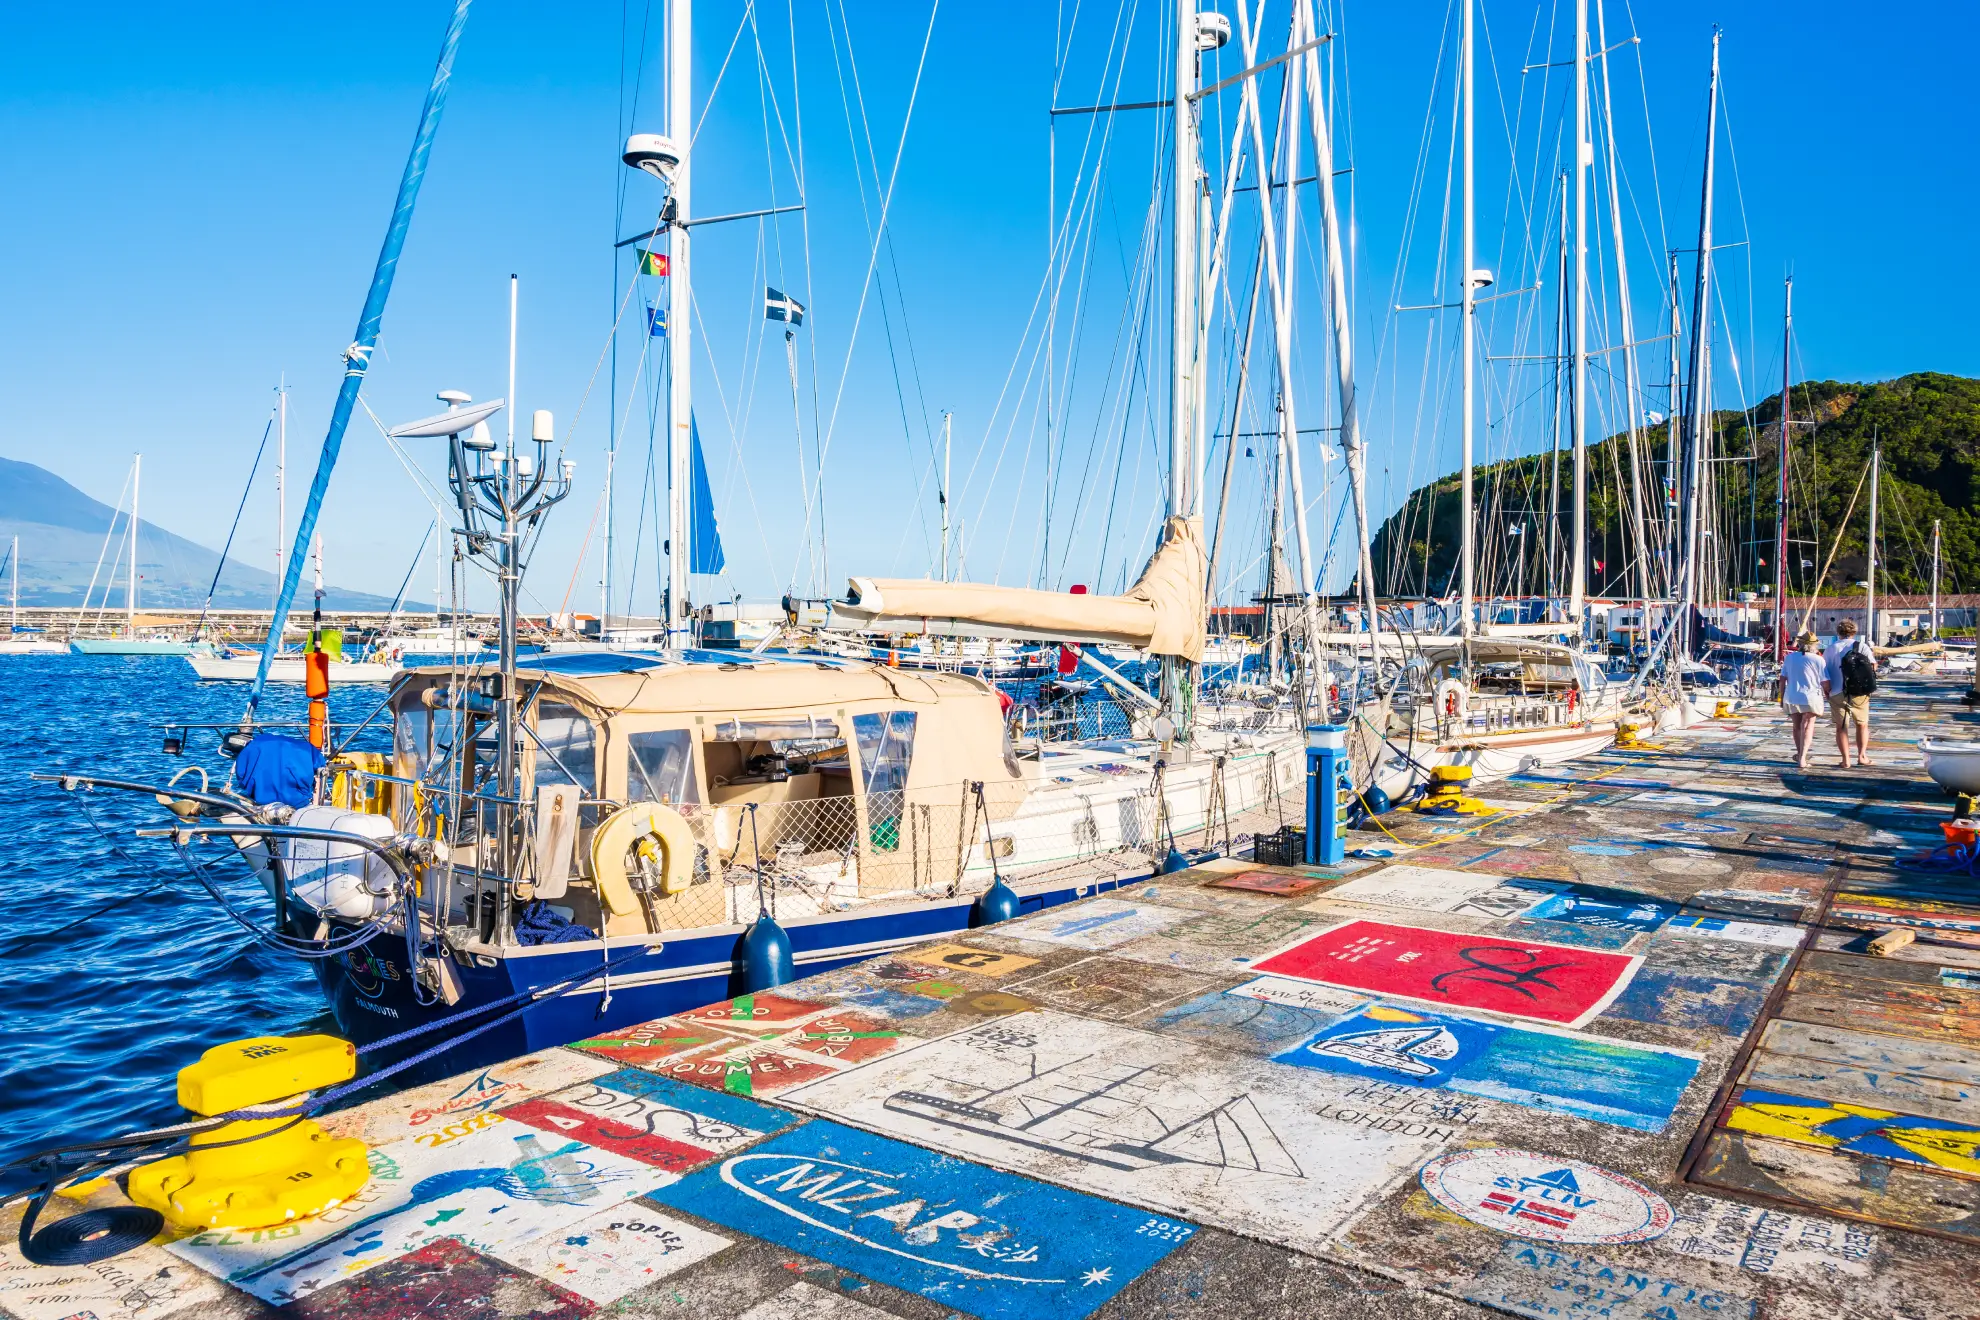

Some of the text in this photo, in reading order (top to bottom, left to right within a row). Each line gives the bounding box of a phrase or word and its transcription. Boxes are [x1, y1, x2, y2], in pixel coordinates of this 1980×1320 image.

[679, 1007, 770, 1022] 2020
[623, 1023, 668, 1048] 2019
[286, 1171, 313, 1182] 19
[609, 1222, 685, 1252] POPSEA
[1506, 1225, 1564, 1242] 2023
